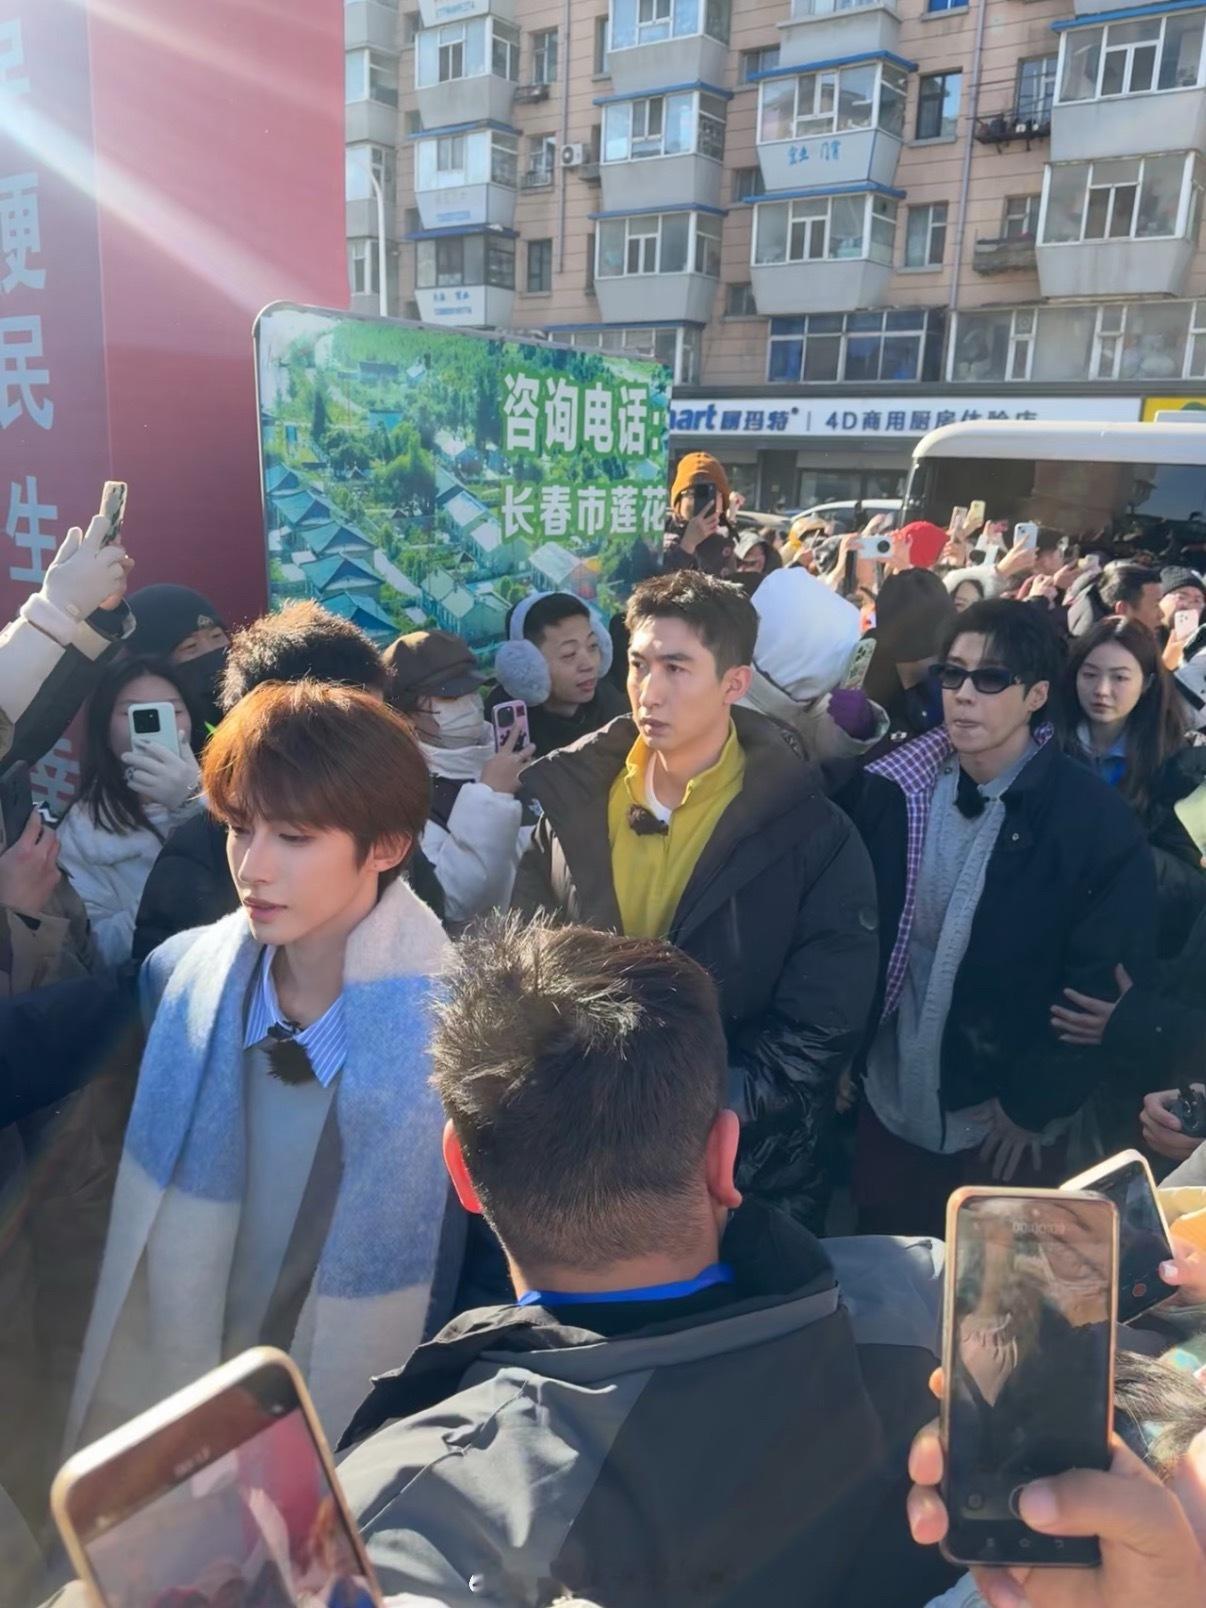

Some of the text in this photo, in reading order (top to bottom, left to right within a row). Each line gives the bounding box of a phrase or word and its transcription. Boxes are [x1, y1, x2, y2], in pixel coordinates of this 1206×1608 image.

[503, 372, 661, 455] 咨询电话：
[501, 484, 666, 538] 长春市莲花
